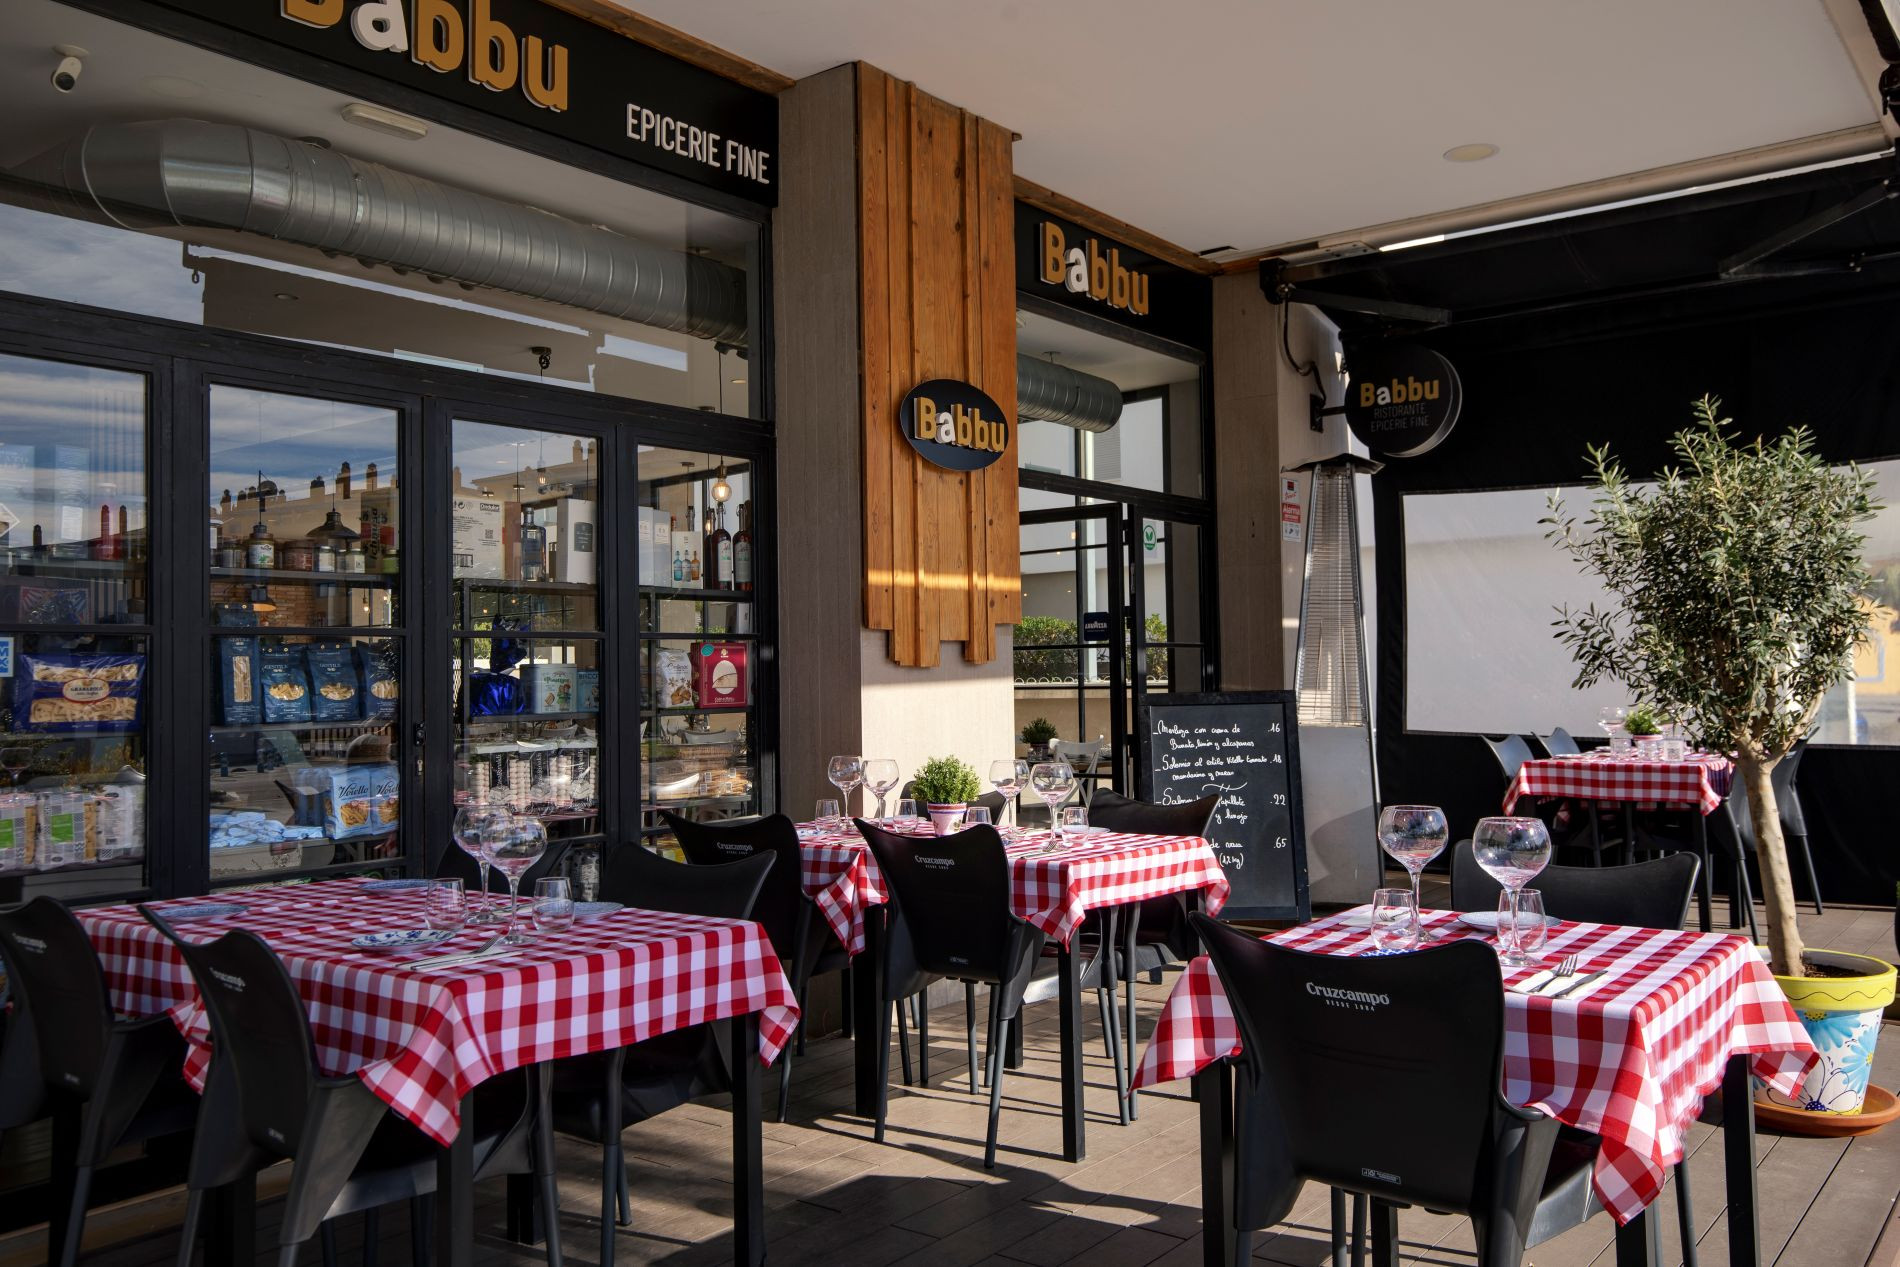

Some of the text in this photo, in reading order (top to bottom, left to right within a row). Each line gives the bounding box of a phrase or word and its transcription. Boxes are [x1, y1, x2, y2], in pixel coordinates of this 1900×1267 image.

[280, 0, 568, 112] abbu
[626, 103, 770, 184] EPICERIE FINE
[1040, 221, 1149, 316] Babbu
[1360, 376, 1439, 408] Babbu
[1374, 402, 1426, 419] RISTORANTE
[914, 396, 1005, 453] Babbu
[1371, 415, 1429, 432] EPICERIE FINE
[1232, 723, 1241, 733] de
[716, 841, 754, 851] Cruzcampo
[914, 855, 955, 867] Cruzcampo
[1305, 981, 1390, 1006] Cruzcampo
